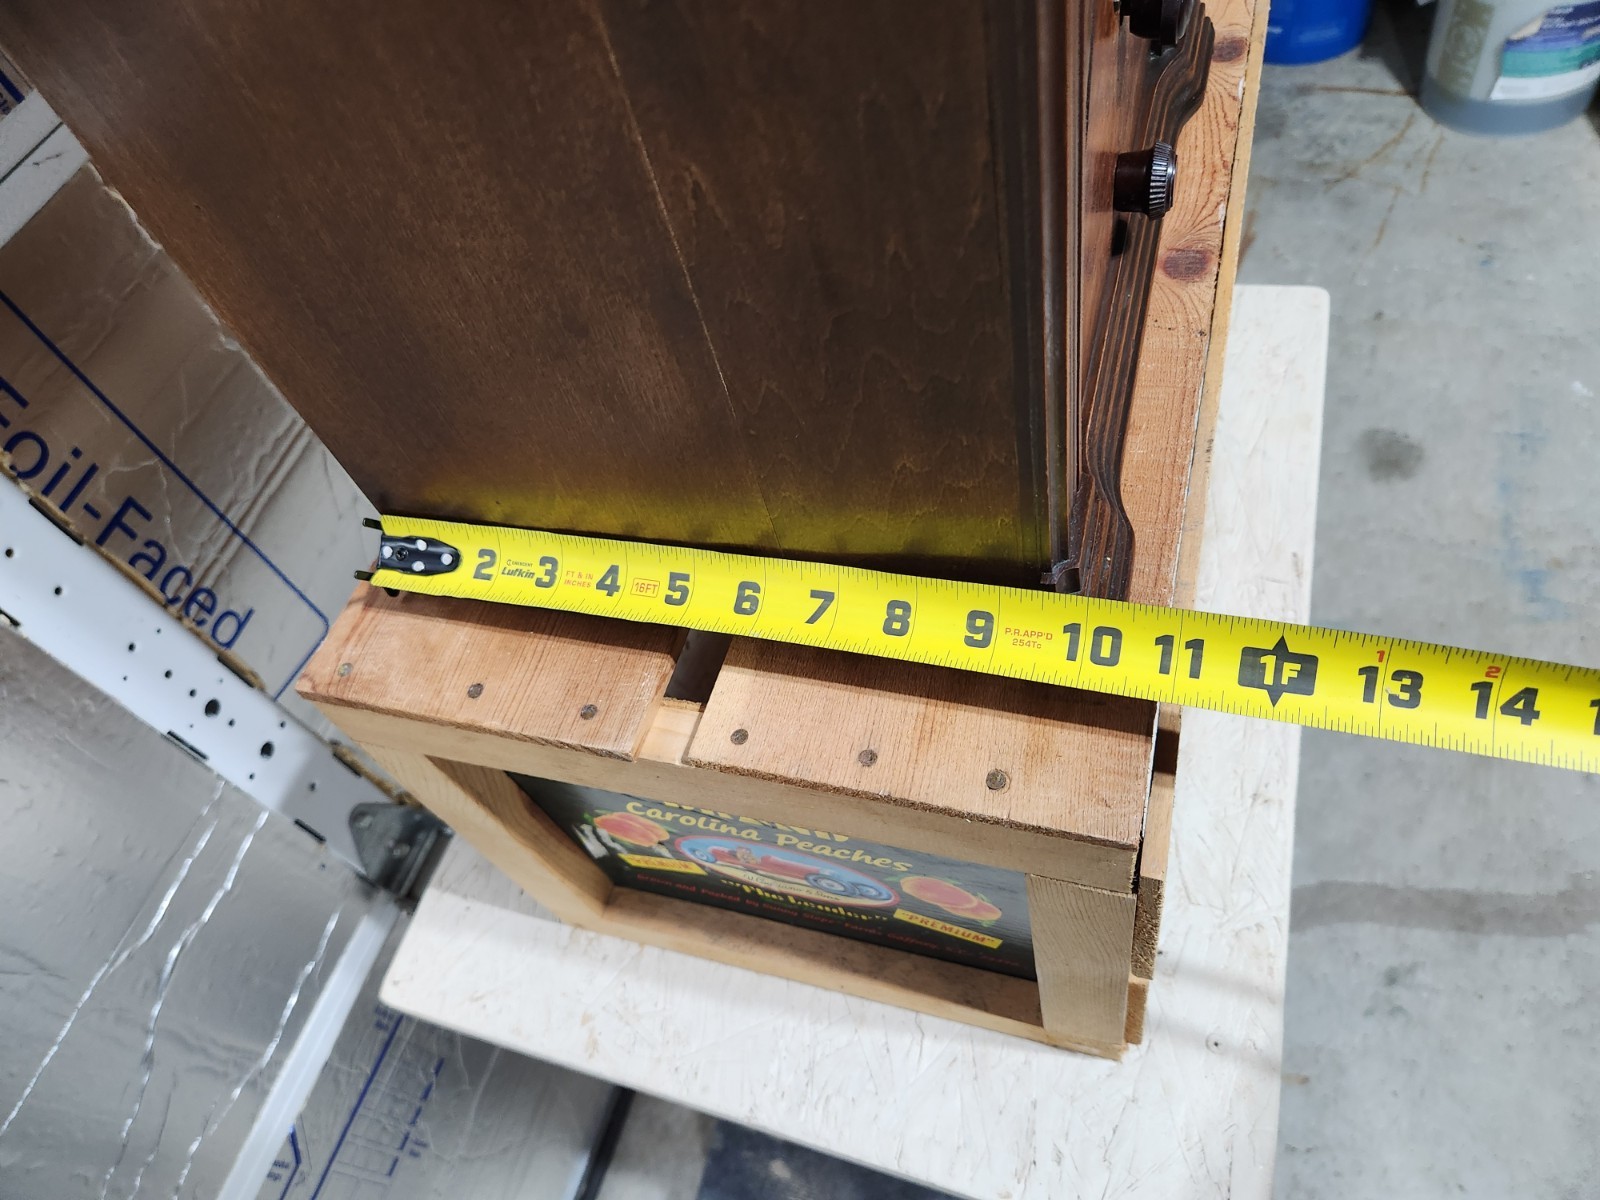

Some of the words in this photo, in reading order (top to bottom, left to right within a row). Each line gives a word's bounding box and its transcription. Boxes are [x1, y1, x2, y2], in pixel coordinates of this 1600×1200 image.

[473, 549, 497, 581] 2
[501, 567, 535, 579] Lufkin
[535, 556, 558, 588] 3
[565, 570, 575, 578] FT
[596, 565, 621, 597] 4
[564, 579, 591, 588] INCHES
[634, 582, 658, 594] 16FT
[664, 572, 690, 606] 5
[734, 581, 761, 615] 6
[805, 589, 835, 624] 7
[882, 600, 912, 636] 8
[964, 610, 994, 648] 9
[1005, 627, 1053, 641] P.R.APP'D
[1063, 623, 1123, 667] 10
[1155, 635, 1205, 679] 11
[1259, 654, 1302, 686] 1F
[1377, 650, 1385, 662] 1
[1485, 666, 1501, 678] 2
[1358, 666, 1424, 709] 13
[1471, 681, 1540, 726] 14
[626, 801, 762, 841] Carolina
[774, 832, 914, 872] Peaches
